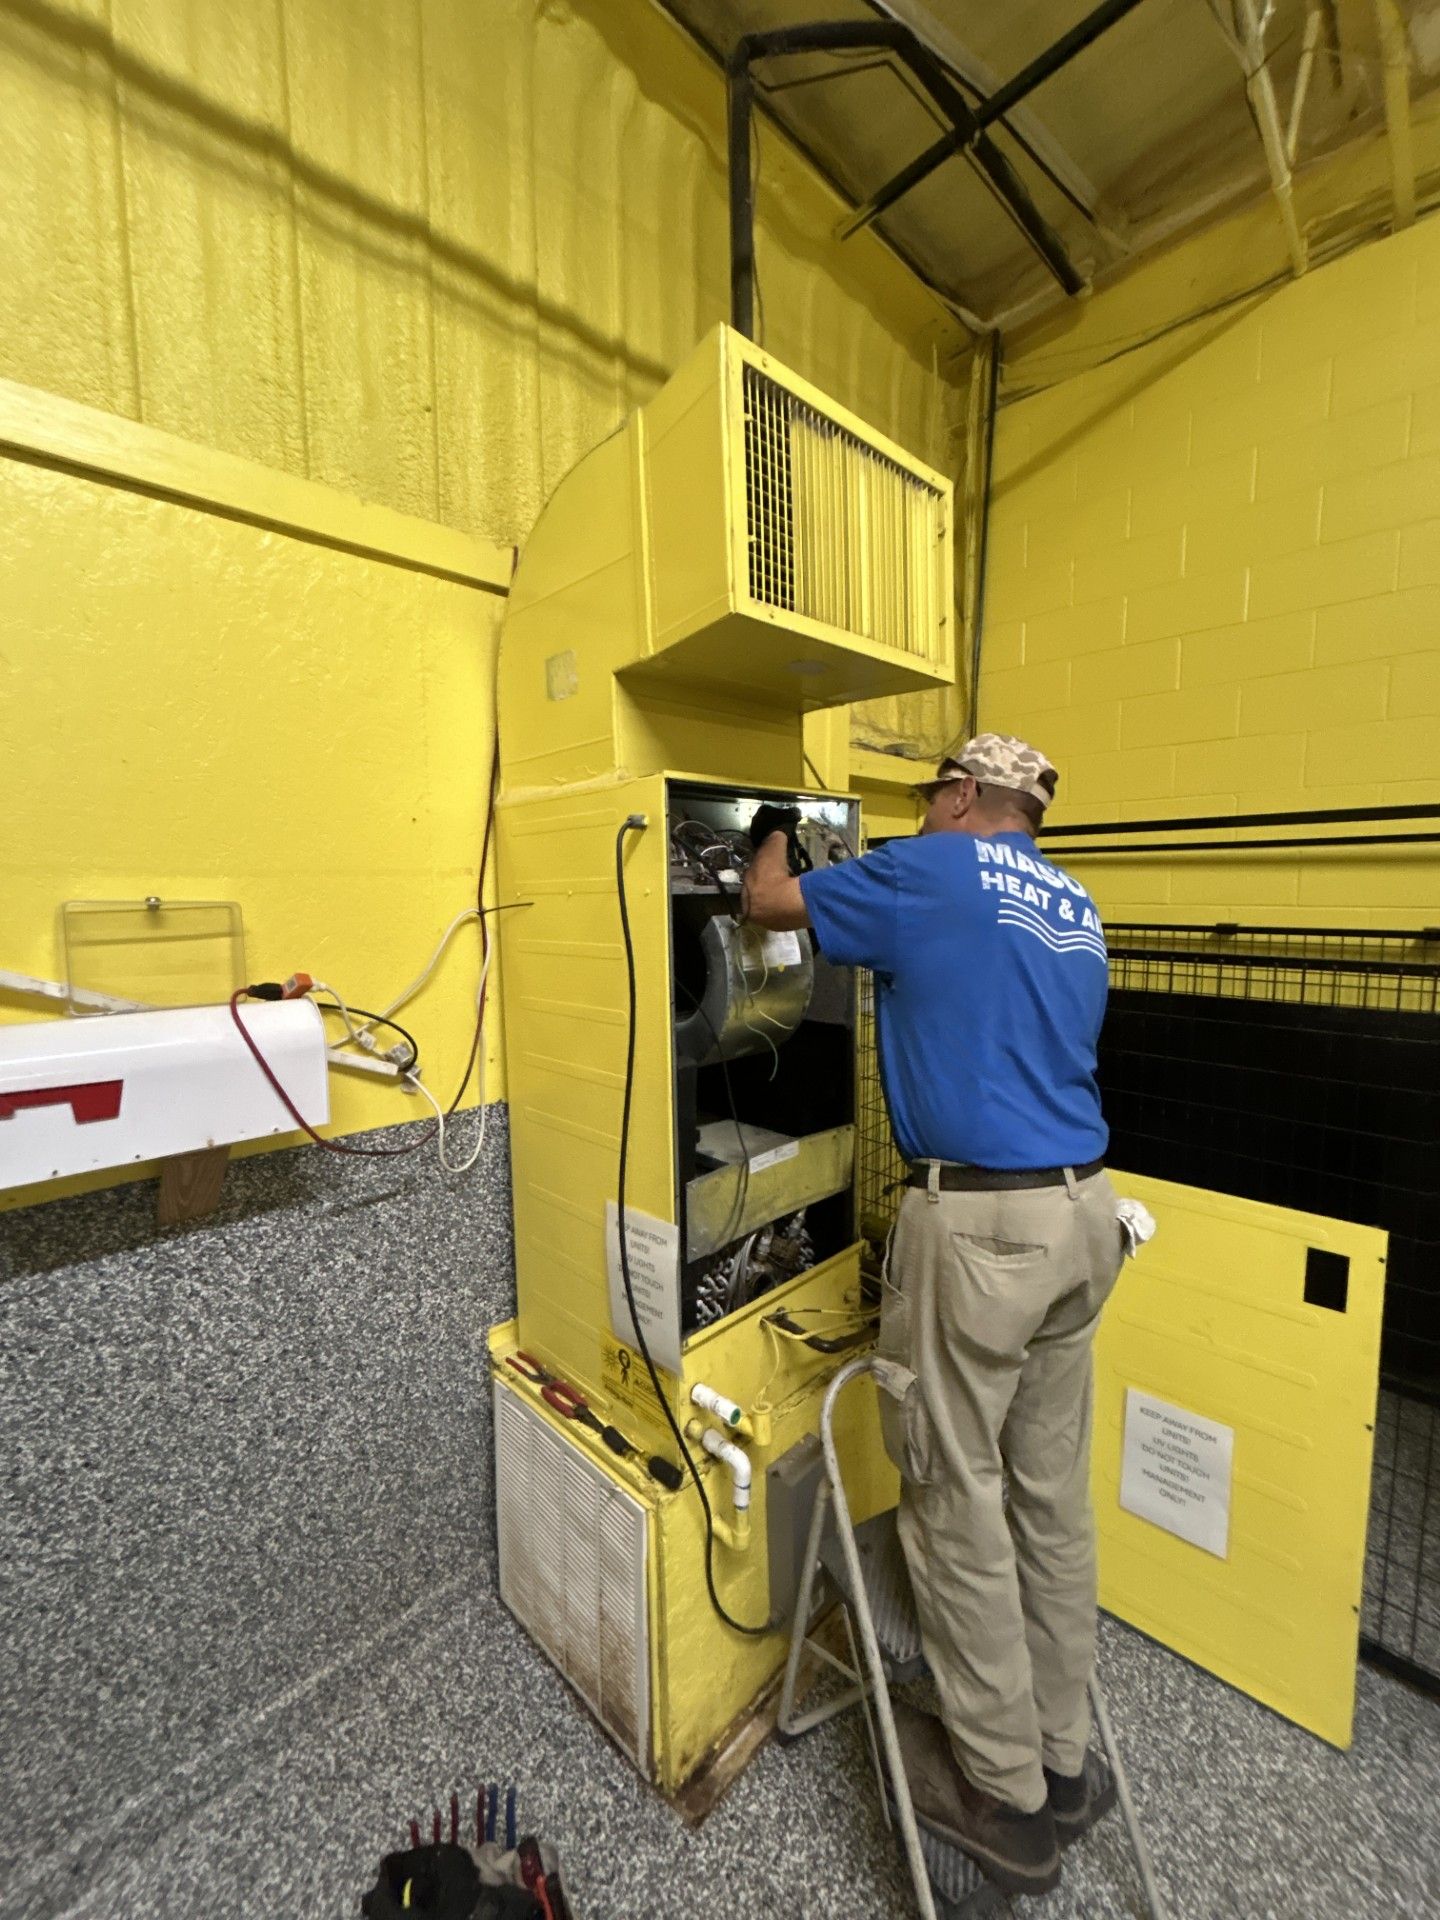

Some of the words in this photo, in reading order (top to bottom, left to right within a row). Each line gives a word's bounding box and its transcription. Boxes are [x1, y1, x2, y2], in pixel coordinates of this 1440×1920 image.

[974, 839, 1090, 899] MASO
[980, 870, 1052, 910] HEAT
[1058, 898, 1076, 923] &
[1140, 1407, 1162, 1420] KEEP
[1162, 1417, 1188, 1431] AWAY
[1189, 1426, 1217, 1444] FROM
[1142, 1443, 1156, 1455] DO
[1156, 1451, 1175, 1463] NOT
[1177, 1459, 1210, 1480] TOUCH
[1166, 1443, 1199, 1463] LIGHTS
[1142, 1468, 1206, 1504] MANAGEMENT
